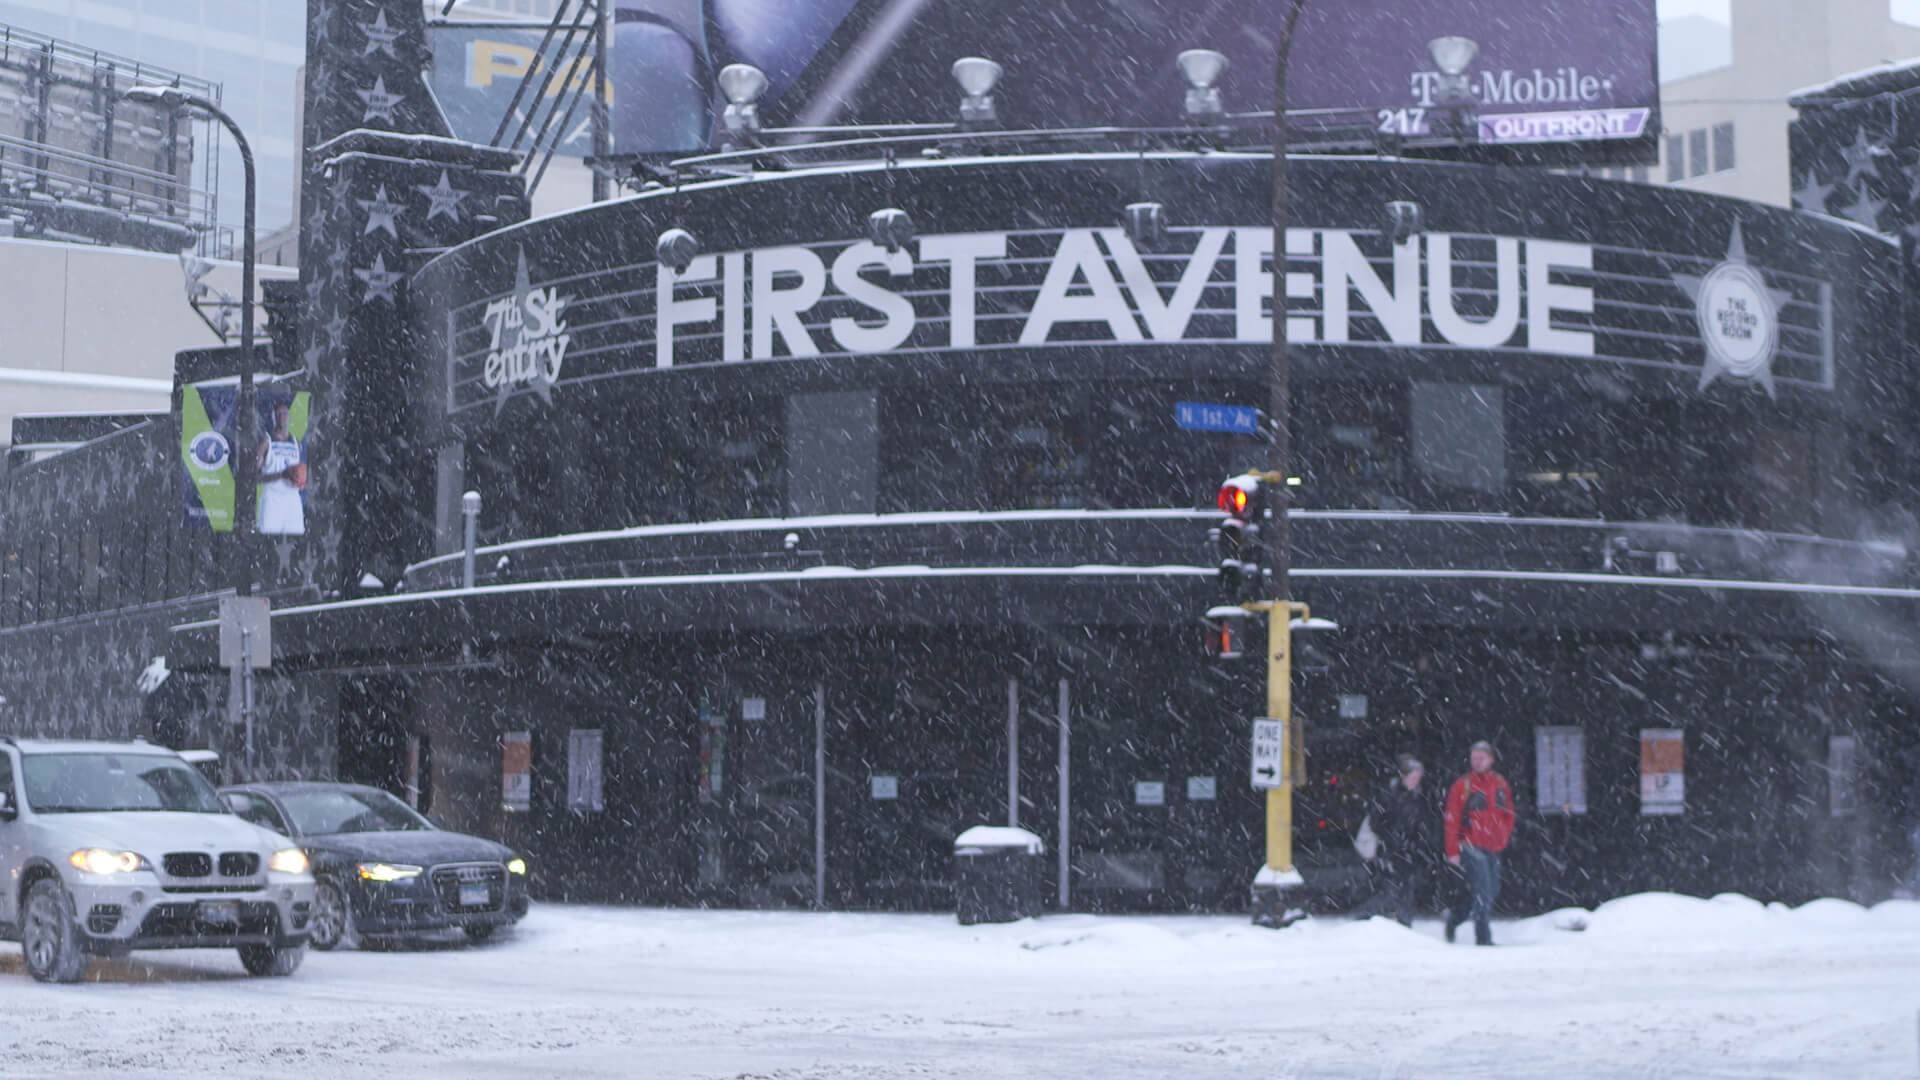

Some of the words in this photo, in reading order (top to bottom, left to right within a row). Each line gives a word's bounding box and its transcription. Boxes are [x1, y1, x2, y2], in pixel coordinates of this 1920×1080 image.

[1377, 108, 1425, 135] 217
[1494, 113, 1630, 138] OUTFRONT
[656, 233, 1007, 369] FIRST
[1018, 227, 1596, 356] AVENUE
[1727, 297, 1747, 312] THE
[483, 295, 522, 350] 7th
[523, 286, 566, 340] St
[484, 331, 570, 389] entry
[1181, 407, 1193, 424] N
[1255, 725, 1279, 742] ONE
[1256, 743, 1278, 760] WAY
